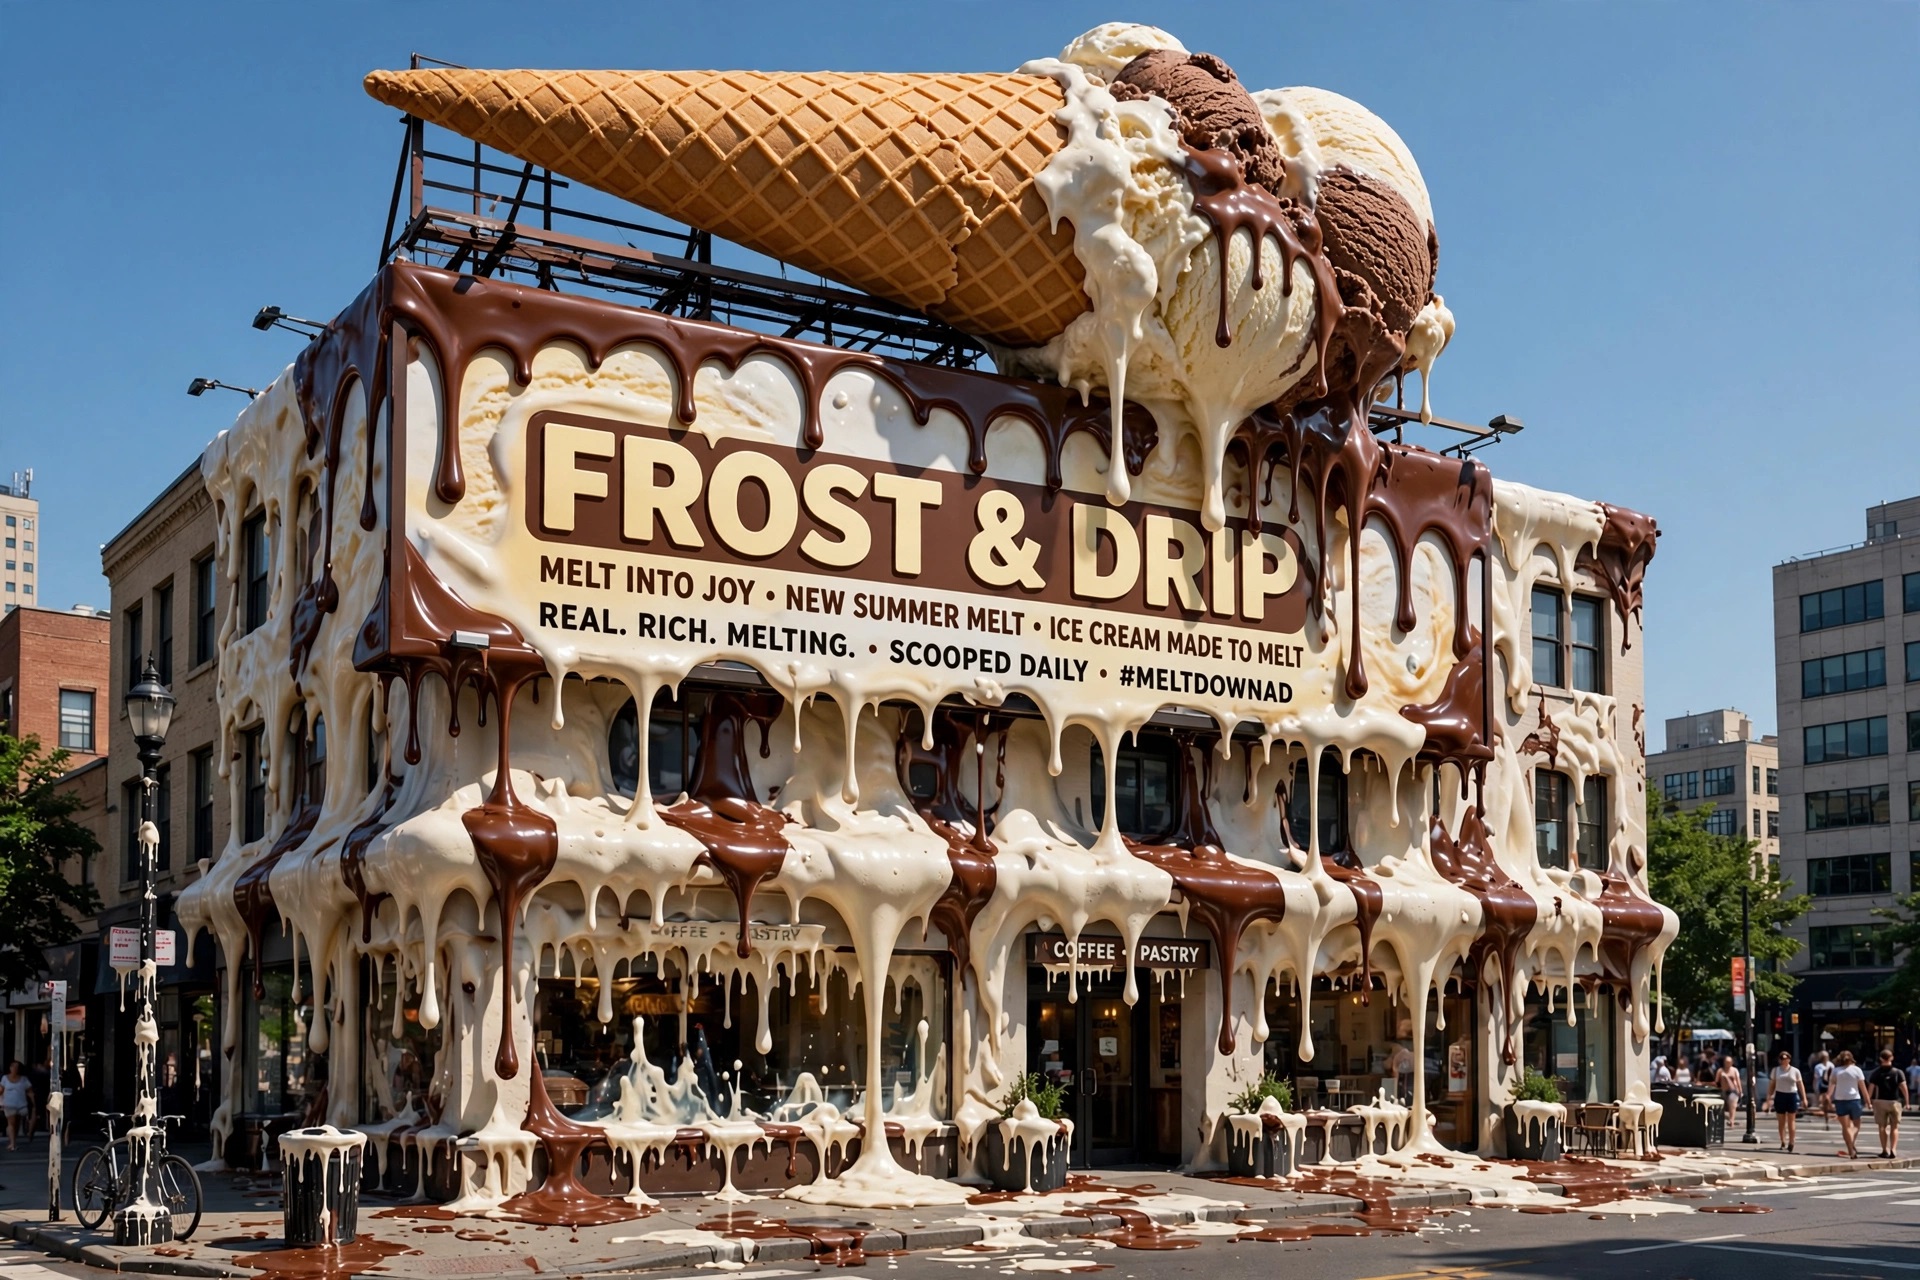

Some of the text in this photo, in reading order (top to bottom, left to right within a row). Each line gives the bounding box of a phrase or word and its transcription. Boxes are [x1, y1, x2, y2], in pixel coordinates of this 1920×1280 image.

[542, 422, 1298, 620] FROST & DRIP
[539, 602, 1293, 704] REAL. RICH. MELTING. SCOOPED DAILY #MELTDOWNAD
[540, 555, 1304, 668] MELT INTO JOY NEW SUMMER MELT ICE CREAM MADE TO MELT
[1053, 941, 1200, 963] COFFEE PASTRY
